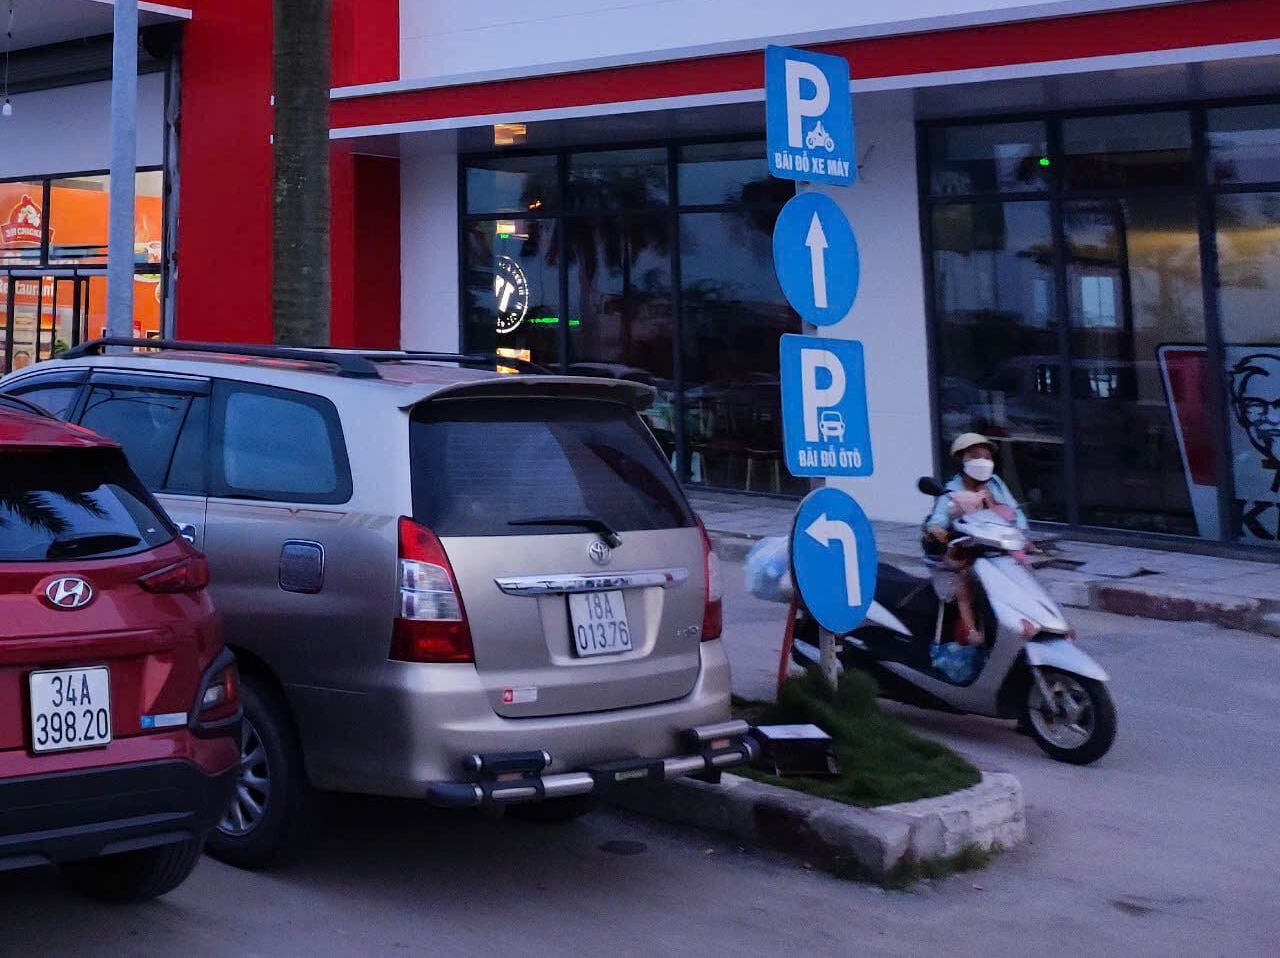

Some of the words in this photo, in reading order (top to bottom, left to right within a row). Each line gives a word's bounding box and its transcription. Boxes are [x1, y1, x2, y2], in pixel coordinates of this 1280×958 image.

[785, 58, 831, 148] P
[811, 157, 826, 175] XE
[827, 157, 850, 178] MÁY
[801, 348, 846, 442] P
[585, 593, 614, 620] 18A
[51, 673, 91, 707] 34A
[36, 708, 108, 745] 398.20
